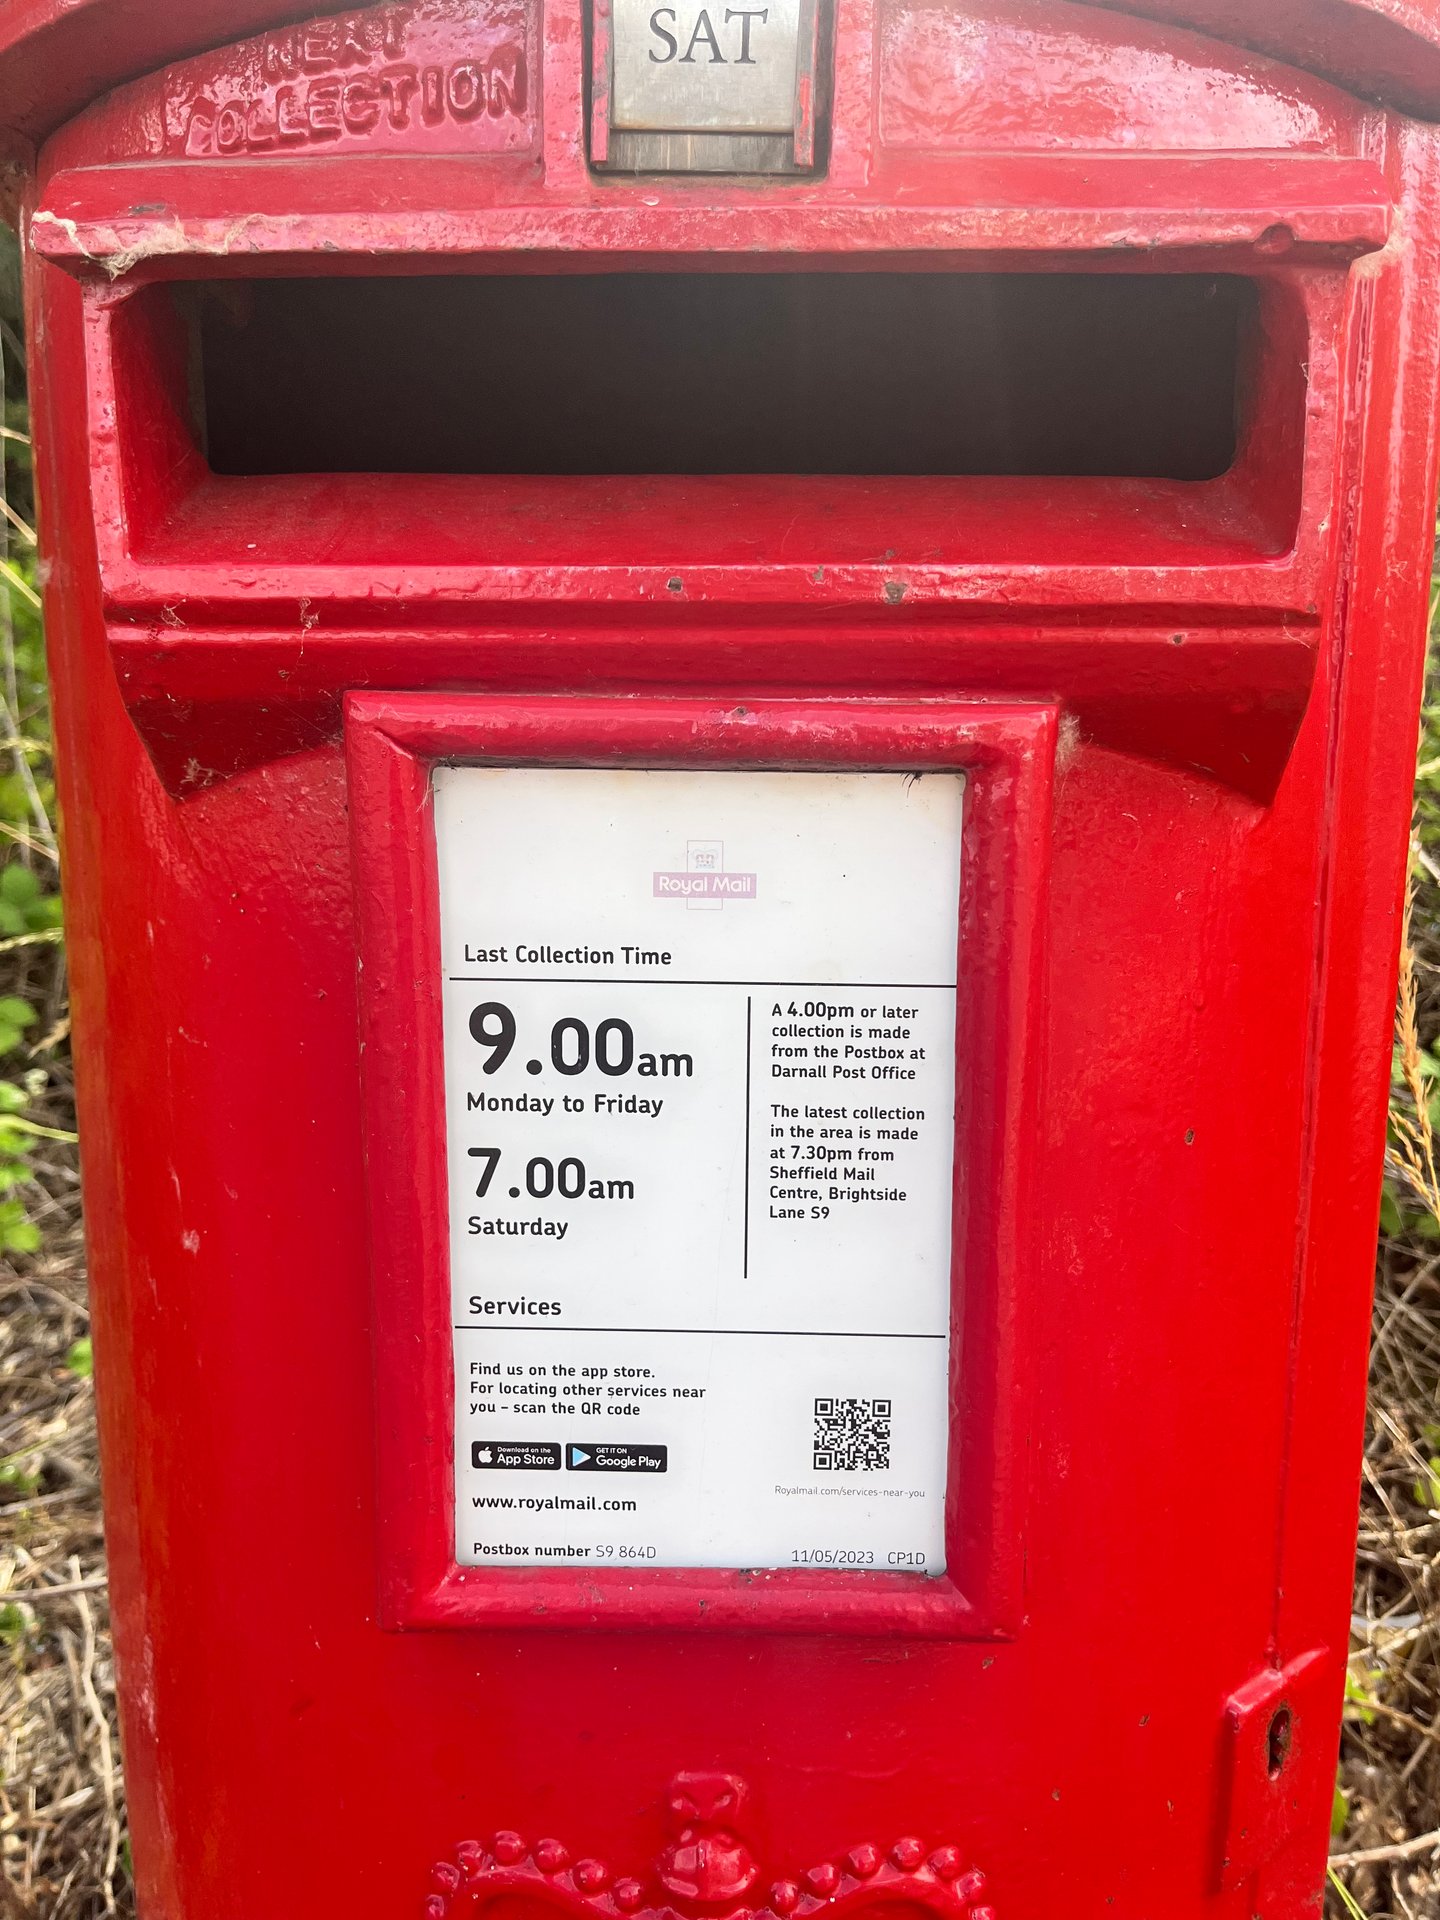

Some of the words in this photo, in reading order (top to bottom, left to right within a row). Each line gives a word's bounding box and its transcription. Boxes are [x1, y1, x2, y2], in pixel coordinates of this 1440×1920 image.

[648, 7, 770, 64] SAT
[187, 44, 527, 155] COLLECTION
[659, 876, 707, 895] Royal
[712, 876, 751, 893] Mail
[464, 943, 509, 963] Last
[516, 945, 613, 964] Collection
[620, 946, 672, 966] Time
[771, 1002, 783, 1017] A
[786, 1001, 855, 1021] 4.00pm
[860, 1007, 878, 1018] or
[882, 1004, 919, 1019] later
[469, 1002, 692, 1077] 9.00am
[772, 1023, 845, 1038] collection
[850, 1024, 863, 1039] is
[868, 1025, 911, 1039] made
[771, 1043, 808, 1058] from
[813, 1044, 839, 1059] the
[844, 1044, 905, 1060] Postbox
[909, 1047, 926, 1060] at
[771, 1063, 827, 1079] Darnall
[832, 1064, 867, 1079] Post
[871, 1065, 916, 1080] Office
[468, 1092, 554, 1116] Monday
[562, 1094, 585, 1113] to
[595, 1094, 664, 1116] Friday
[770, 1104, 799, 1118] The
[804, 1104, 848, 1119] latest
[852, 1106, 925, 1121] collection
[770, 1123, 784, 1138] in
[789, 1124, 815, 1138] the
[819, 1128, 854, 1139] area
[858, 1125, 871, 1140] is
[876, 1126, 919, 1141] made
[769, 1147, 786, 1159] at
[790, 1144, 852, 1163] 7.30pm
[857, 1147, 895, 1162] from
[468, 1148, 634, 1199] 7.00am
[769, 1165, 838, 1180] Sheffield
[843, 1166, 875, 1181] Mail
[769, 1185, 823, 1202] Centre,
[828, 1186, 907, 1203] Brightside
[769, 1205, 805, 1219] Lane
[810, 1205, 830, 1220] S9
[468, 1216, 568, 1240] Saturday
[470, 1296, 561, 1315] Services
[470, 1361, 501, 1376] Find
[506, 1365, 524, 1376] us
[528, 1366, 547, 1376] on
[551, 1363, 576, 1377] the
[581, 1367, 608, 1380] app
[613, 1366, 655, 1379] store.
[470, 1380, 495, 1394] For
[499, 1381, 557, 1398] locating
[562, 1383, 603, 1396] other
[608, 1384, 666, 1397] services
[672, 1388, 707, 1398] near
[469, 1402, 496, 1415] you
[513, 1403, 546, 1414] scan
[551, 1401, 576, 1415] the
[581, 1401, 602, 1415] QR
[607, 1402, 641, 1416] code
[497, 1446, 528, 1454] Download
[497, 1454, 521, 1465] App
[524, 1454, 555, 1465] Store
[596, 1455, 636, 1468] Google
[638, 1456, 661, 1469] Play
[774, 1485, 926, 1499] Royalmail.com/services-near-you
[471, 1495, 637, 1513] www.royalmail.com
[473, 1542, 530, 1556] Postbox
[534, 1544, 592, 1557] number
[595, 1544, 614, 1558] S9
[618, 1545, 657, 1559] 864D
[792, 1549, 874, 1564] 11/05/2023
[887, 1551, 926, 1565] CP1D
